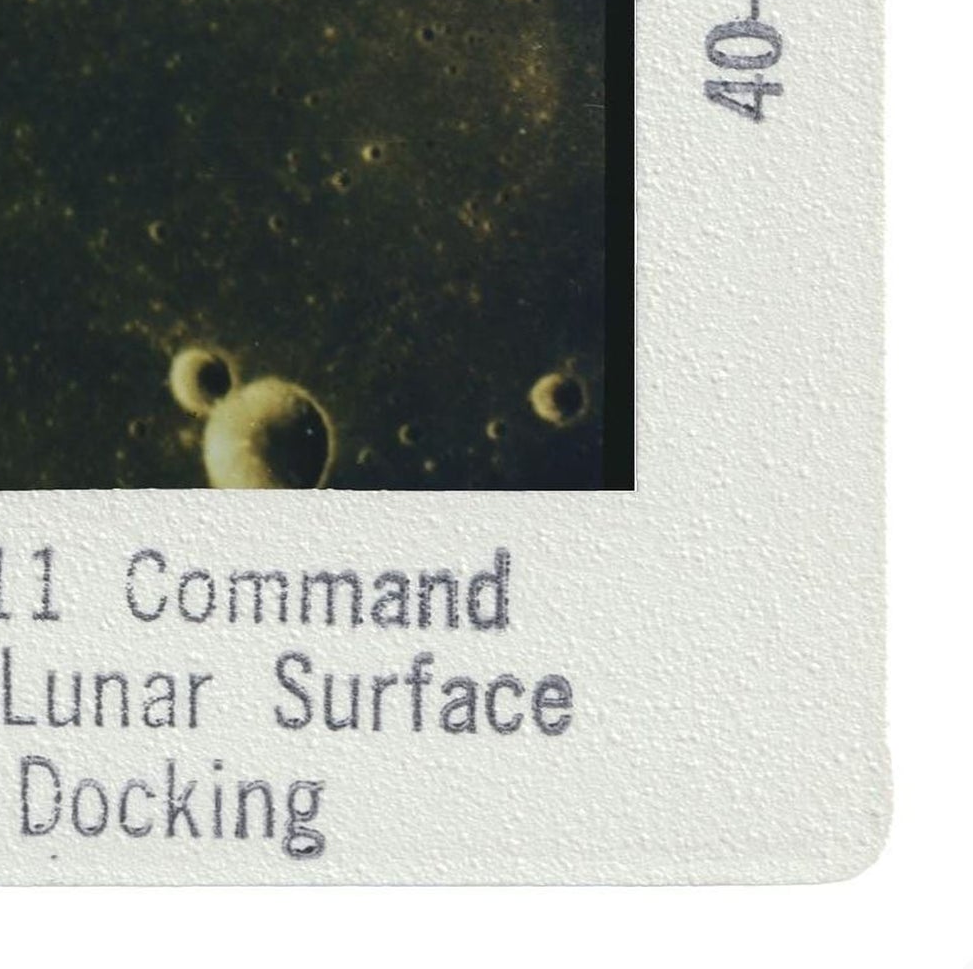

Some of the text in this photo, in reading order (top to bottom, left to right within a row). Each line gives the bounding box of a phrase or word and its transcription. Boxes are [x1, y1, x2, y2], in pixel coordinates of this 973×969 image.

[124, 546, 513, 633] Command
[0, 645, 215, 731] Lunar
[272, 650, 575, 738] Surface
[18, 753, 327, 862] Docking
